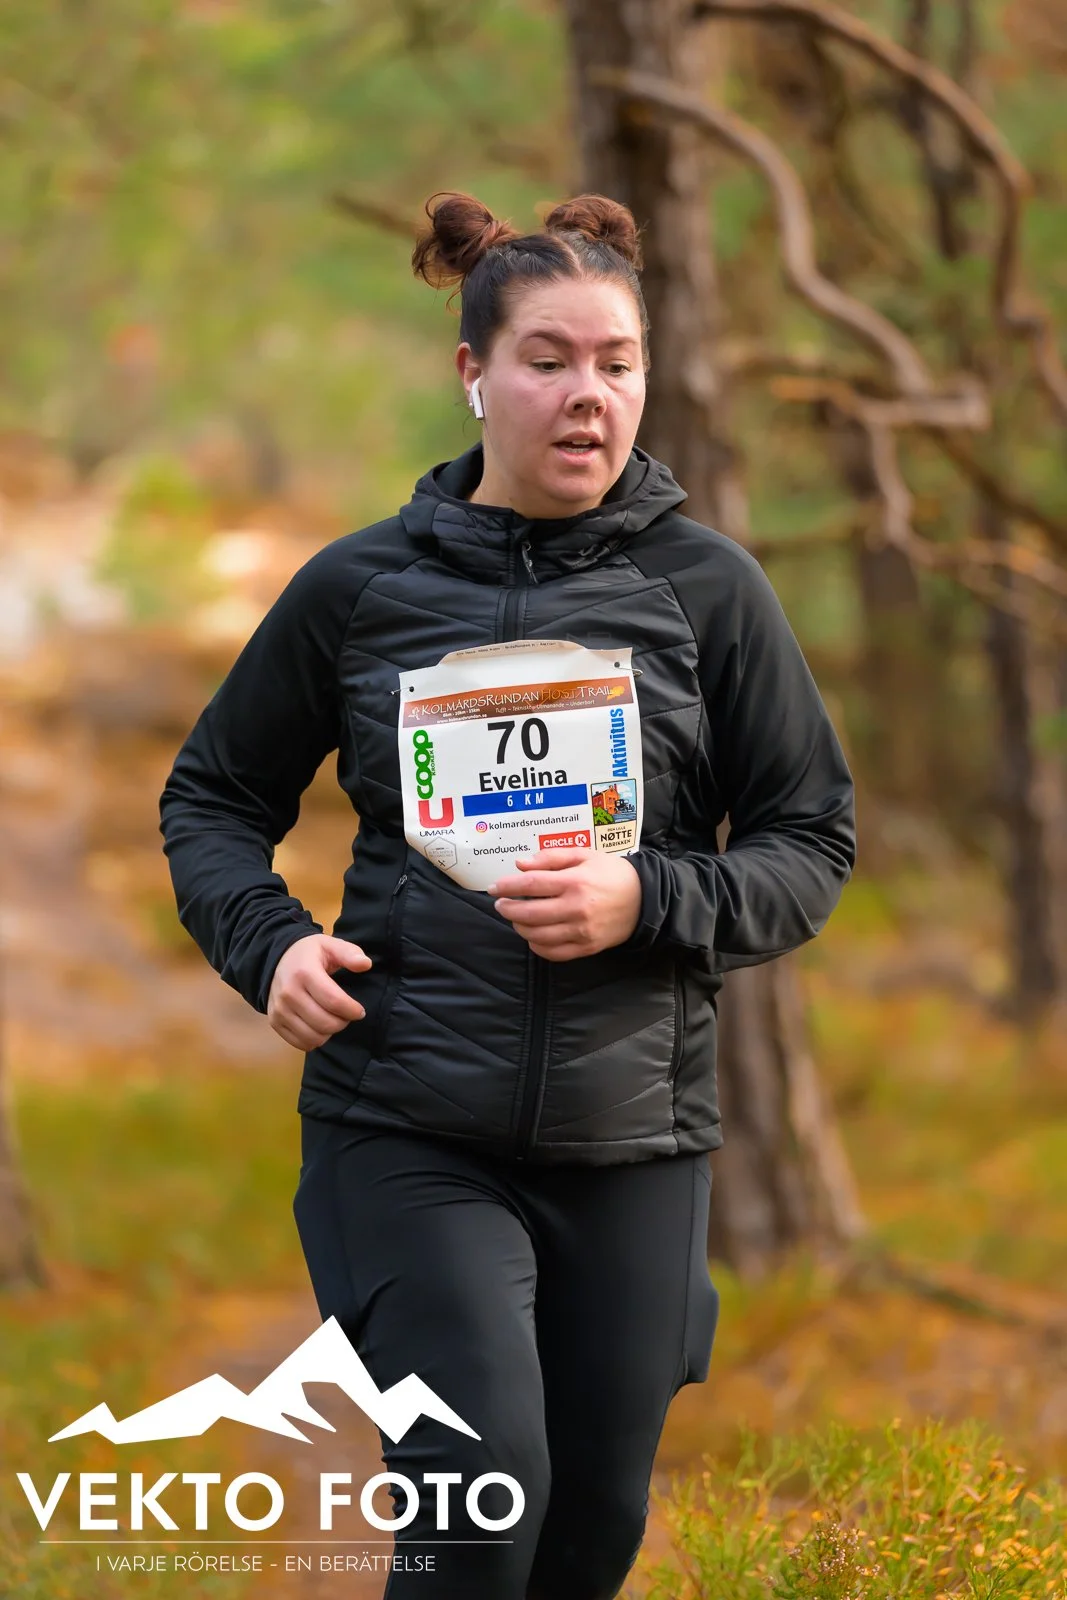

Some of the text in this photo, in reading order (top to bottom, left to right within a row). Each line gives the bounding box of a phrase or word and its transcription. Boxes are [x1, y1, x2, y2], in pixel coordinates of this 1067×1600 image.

[577, 685, 613, 698] TRAIL
[488, 717, 549, 765] 70
[610, 708, 628, 777] Aktivitus
[479, 767, 568, 793] Evelina
[507, 795, 514, 808] 6
[489, 813, 579, 830] kolmardsrundantrail
[420, 829, 455, 837] UMARA
[600, 829, 632, 842] NØTTE
[543, 835, 586, 848] CIRCLE K
[602, 839, 631, 849] FABRIKKEN
[473, 844, 531, 856] brandworks.
